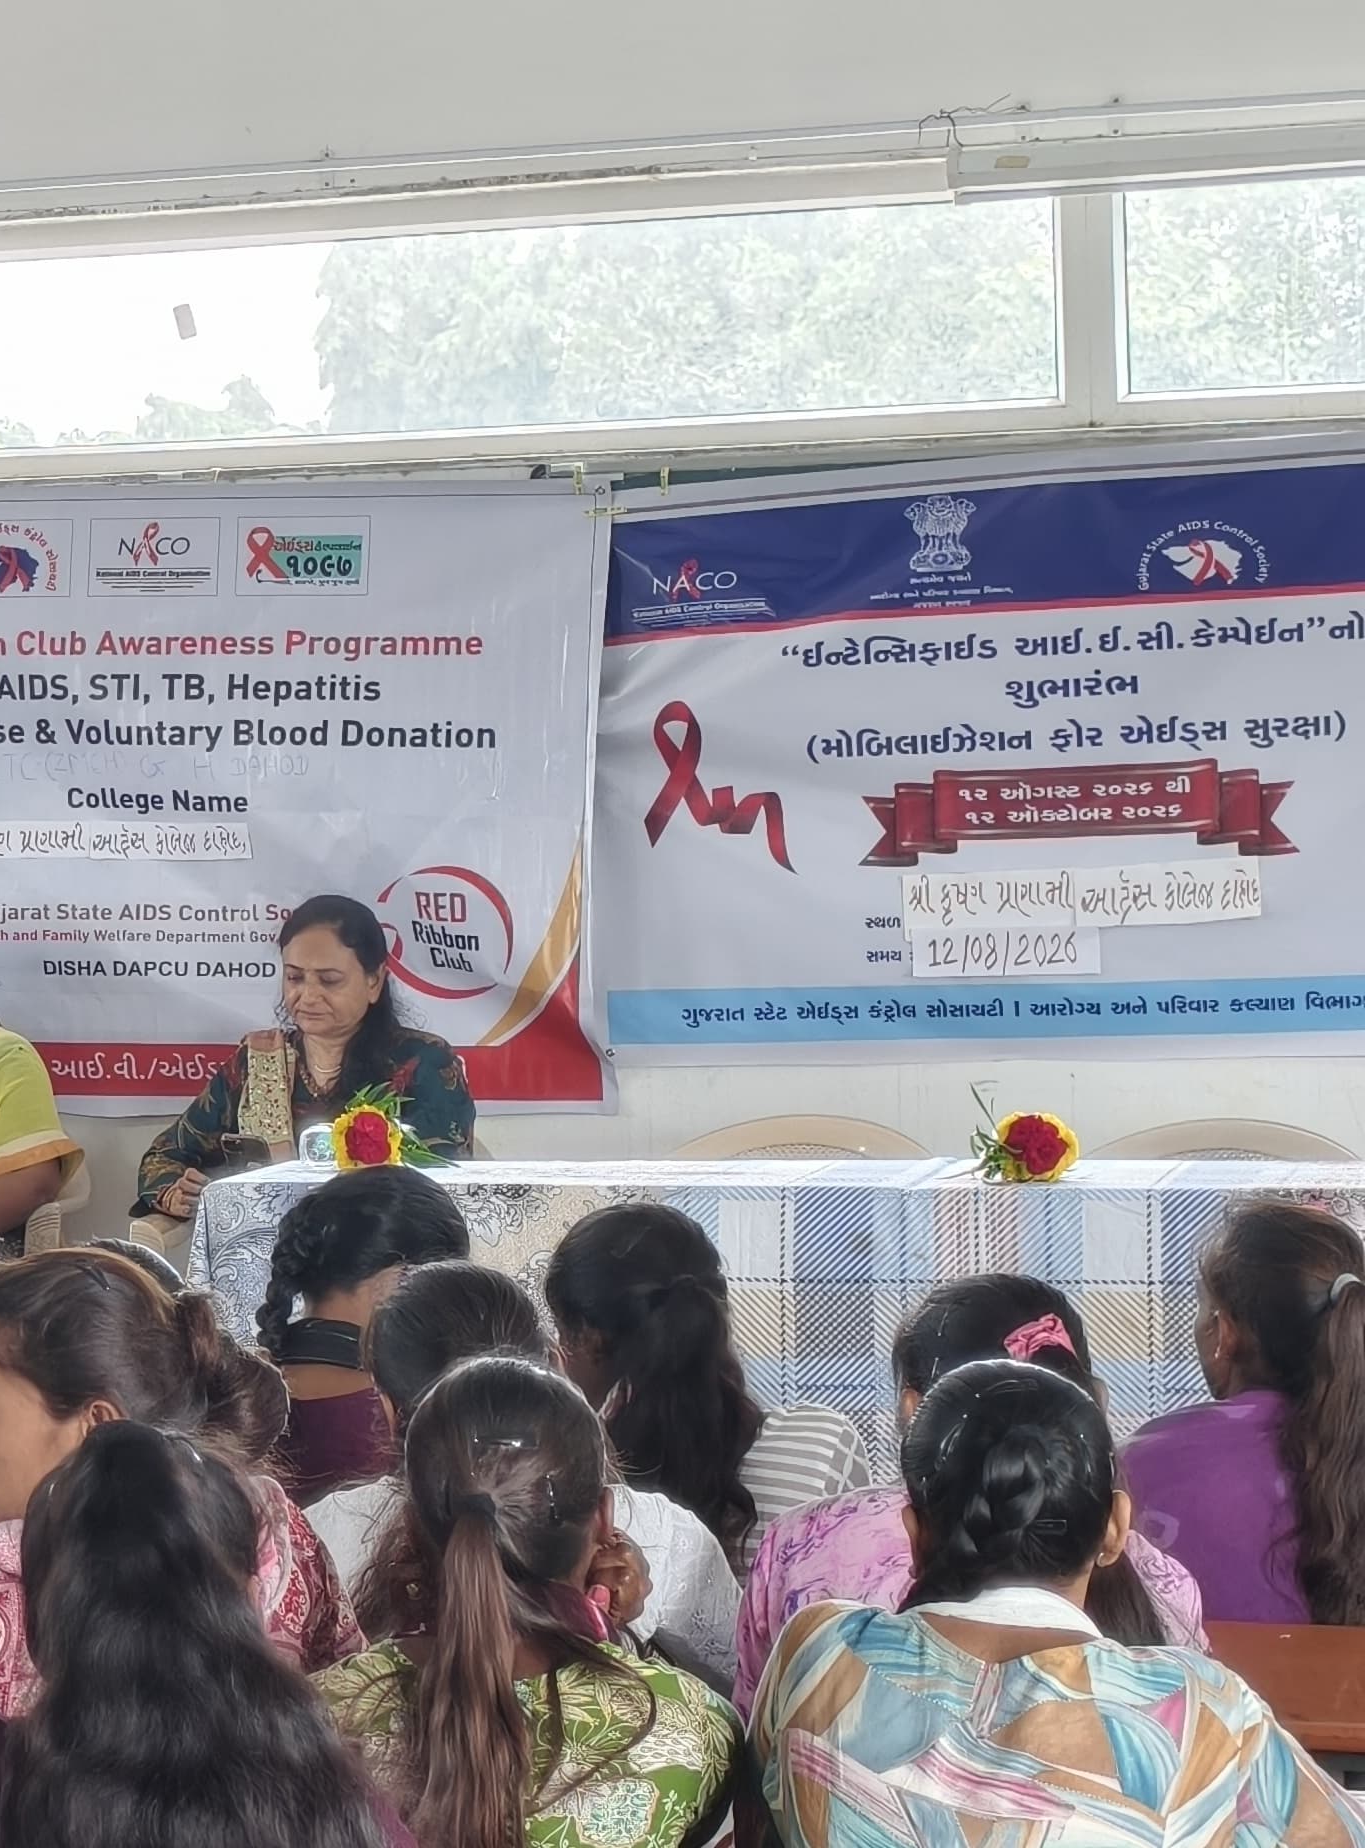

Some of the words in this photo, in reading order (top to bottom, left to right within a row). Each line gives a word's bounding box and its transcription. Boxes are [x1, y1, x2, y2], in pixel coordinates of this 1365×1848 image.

[286, 555, 353, 577] ૧૦૯૭
[1136, 551, 1152, 591] Gujarat
[1146, 530, 1175, 553] State
[1177, 520, 1210, 533] AIDS
[1213, 521, 1260, 547] Control
[1252, 545, 1270, 584] Society
[652, 567, 738, 599] NACO
[16, 630, 87, 656] Club
[95, 630, 275, 657] Awareness
[285, 630, 484, 662] Programme
[88, 673, 151, 706] STI,
[162, 673, 216, 706] TB,
[226, 673, 382, 707] Hepatitis
[1005, 669, 1140, 709] શુભારંભ
[35, 719, 58, 744] &
[64, 718, 224, 752] Voluntary
[233, 719, 329, 746] Blood
[340, 719, 497, 749] Donation
[806, 723, 1033, 764] (મોબિલાઈઝેશન
[1049, 718, 1104, 752] ફોર
[1119, 714, 1228, 752] એઈડ્સ
[1243, 710, 1347, 749] સુરક્ષા)
[1165, 775, 1191, 794] થી
[67, 787, 165, 815] College
[172, 790, 249, 813] Name
[57, 903, 113, 922] State
[119, 904, 172, 922] AIDS
[178, 904, 259, 922] Control
[415, 891, 468, 923] RED
[12, 929, 38, 943] and
[42, 929, 90, 945] Family
[94, 928, 151, 943] Welfare
[156, 929, 246, 944] Department
[411, 920, 480, 951] Ribbon
[43, 959, 107, 977] DISHA
[112, 960, 189, 978] DAPCU
[195, 960, 277, 978] DAHOD
[429, 946, 474, 973] Club
[866, 950, 902, 963] સમય
[928, 930, 1078, 976] 12/08/2026
[680, 1005, 745, 1029] ગુજરાત
[754, 1001, 788, 1021] સ્ટેટ
[796, 1001, 860, 1026] એઈડ્સ
[868, 999, 917, 1024] કંટ્રોલ
[925, 998, 1004, 1018] સોસાયટી
[1029, 996, 1102, 1016] આરોગ્ય
[1110, 995, 1148, 1016] અને
[1156, 994, 1220, 1014] પરિવાર
[1229, 996, 1295, 1012] કલ્યાણ
